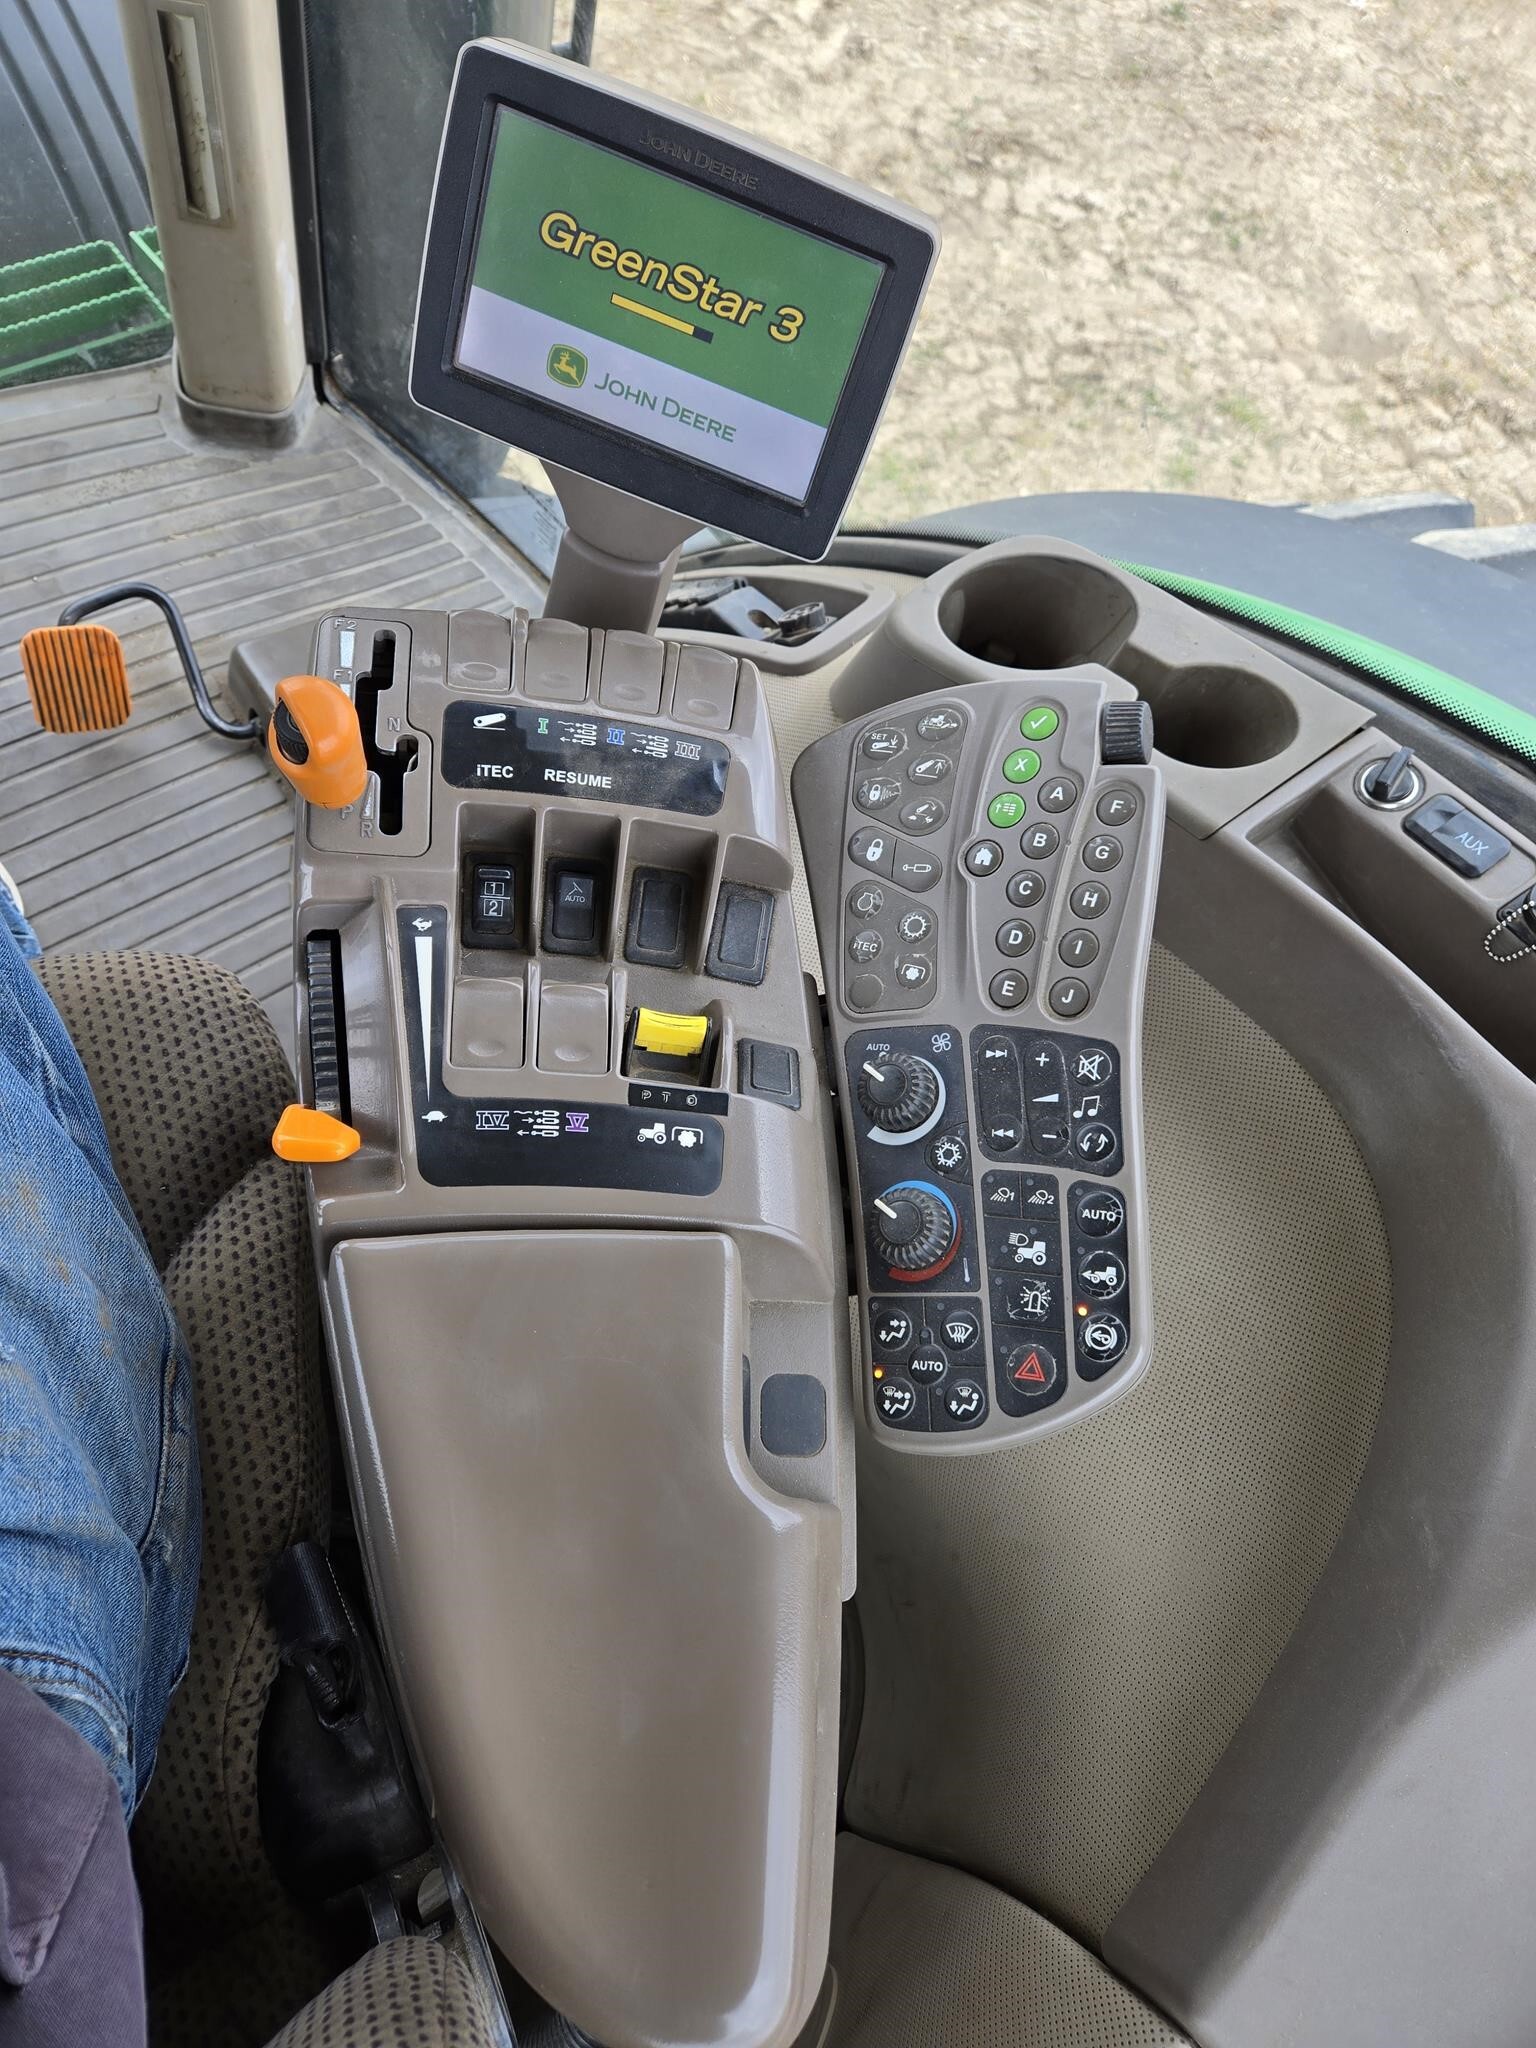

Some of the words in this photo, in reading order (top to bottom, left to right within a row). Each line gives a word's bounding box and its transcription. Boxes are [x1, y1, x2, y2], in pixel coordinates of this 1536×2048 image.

[640, 127, 691, 162] JOHN
[694, 150, 759, 190] DEERE
[539, 210, 765, 326] GreenStar
[768, 306, 805, 343] 3
[594, 372, 658, 411] JOHN
[662, 397, 737, 443] DEERE
[388, 717, 401, 731] N
[871, 732, 888, 740] SET
[476, 764, 514, 778] iTEC
[544, 768, 612, 789] RESUME
[1049, 786, 1064, 801] A
[1110, 799, 1124, 813] F
[361, 821, 373, 838] R
[1032, 833, 1047, 847] B
[1455, 831, 1489, 856] AUX
[1095, 845, 1110, 859] G
[1018, 881, 1032, 895] C
[565, 895, 586, 903] AUTO
[1082, 892, 1099, 907] H
[1009, 930, 1023, 945] D
[853, 941, 878, 953] iTEC
[1074, 941, 1083, 955] I
[1001, 980, 1016, 996] E
[1061, 989, 1075, 1004] J
[866, 1043, 890, 1052] AUTO
[1082, 1208, 1116, 1222] AUTO
[911, 1360, 943, 1373] AUTO
